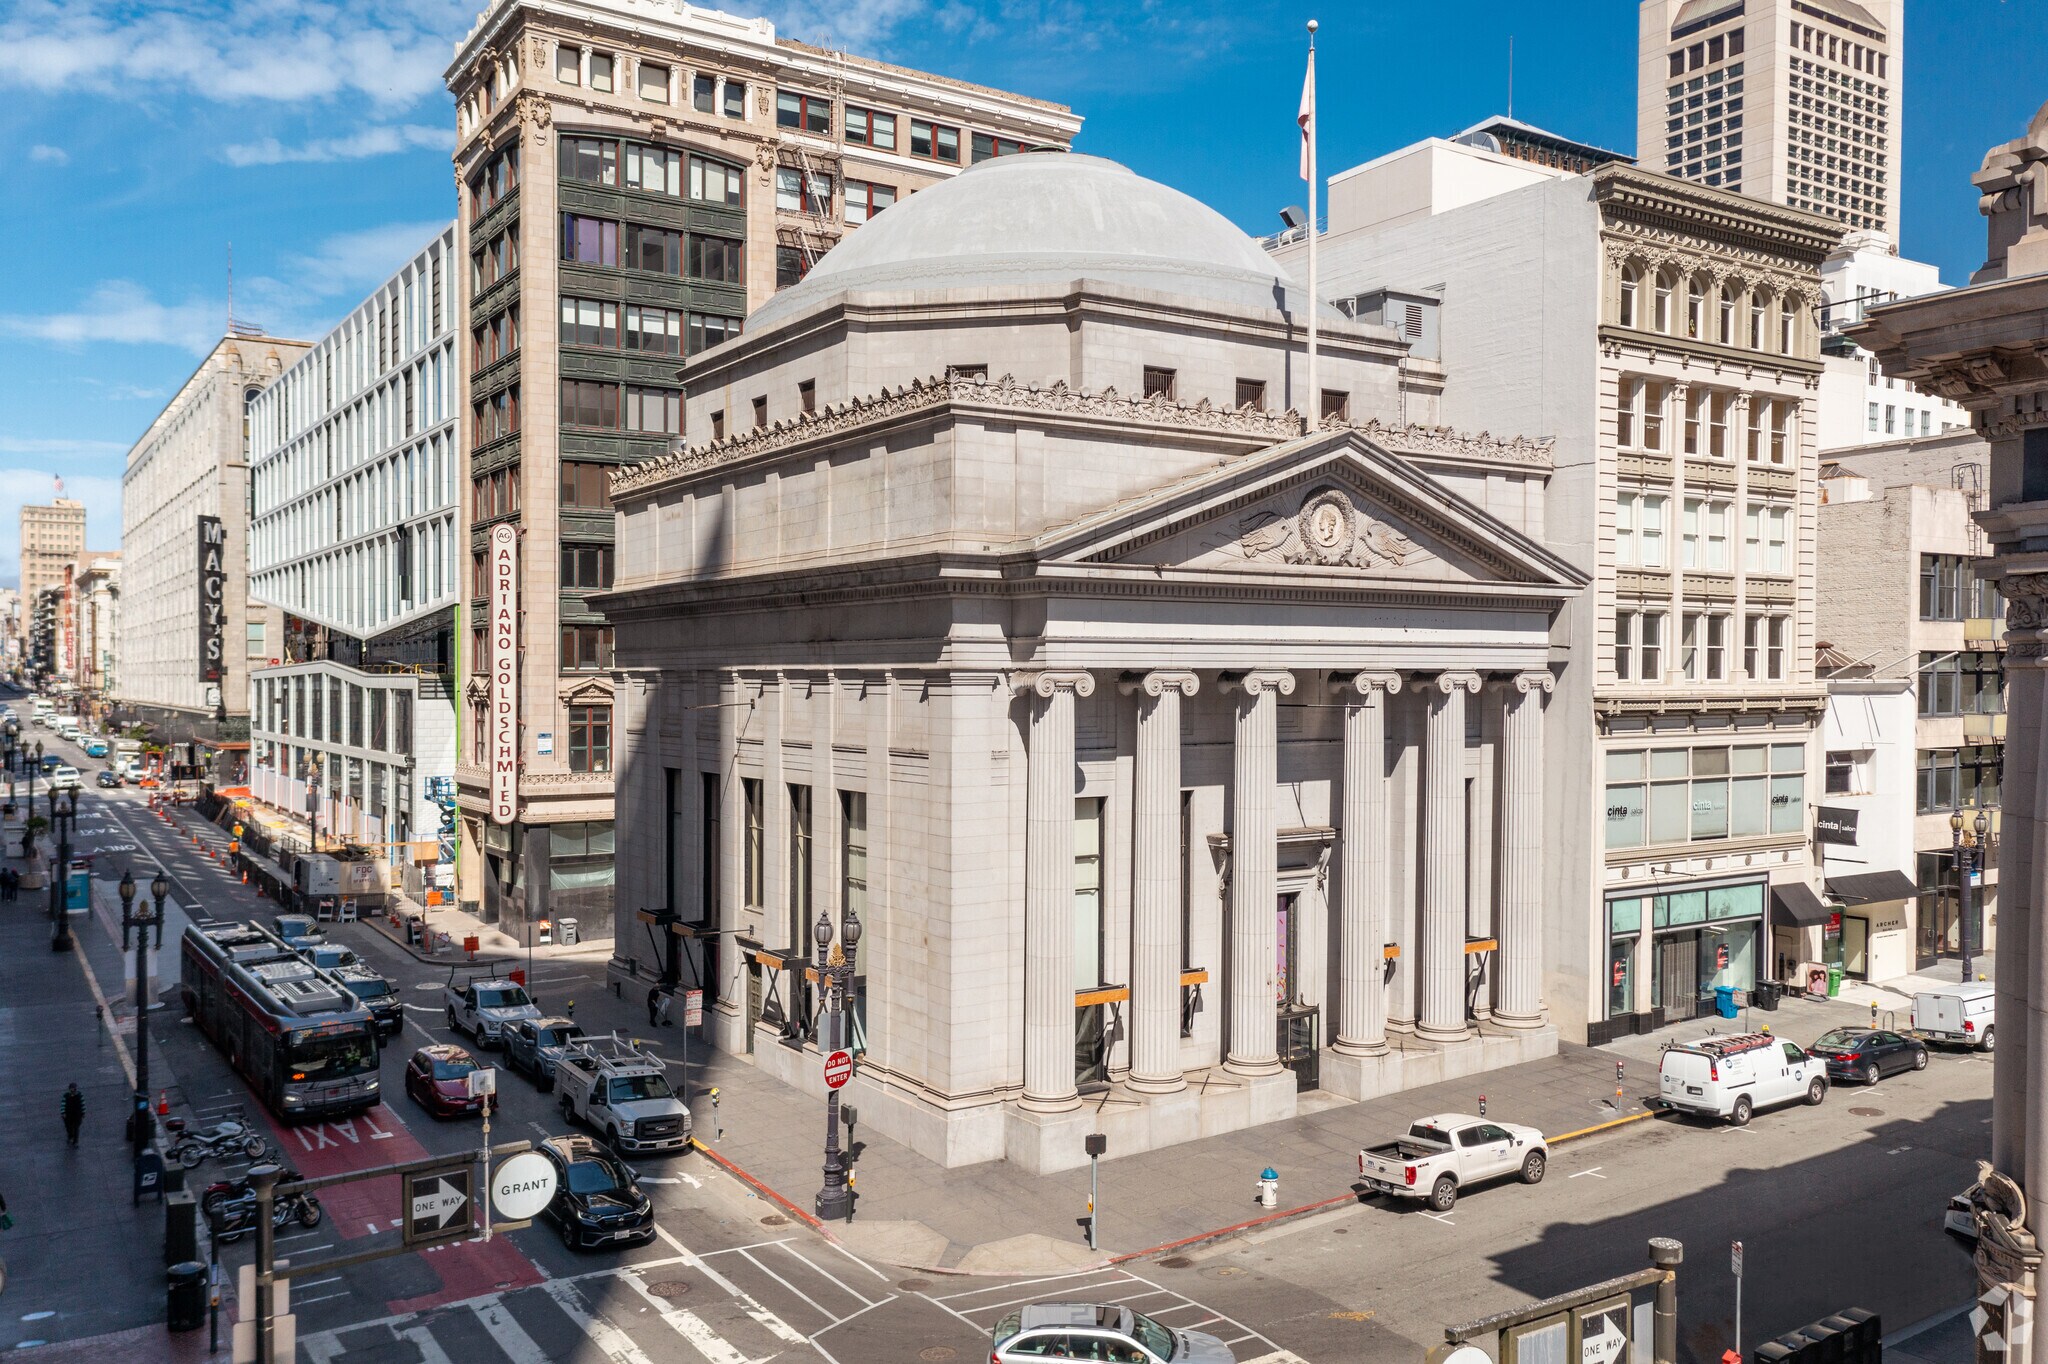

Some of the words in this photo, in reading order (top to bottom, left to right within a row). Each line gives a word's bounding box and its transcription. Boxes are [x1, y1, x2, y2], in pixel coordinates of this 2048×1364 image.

[498, 549, 511, 649] ADRIANO
[497, 658, 513, 816] GOLDSCHMIED
[1607, 805, 1627, 817] cinta
[1693, 799, 1711, 811] cinta
[1818, 820, 1838, 830] cinta
[93, 844, 137, 853] ONLY
[355, 866, 373, 874] FDC
[1876, 919, 1899, 928] ARCHER
[838, 1057, 848, 1065] NOT
[829, 1075, 848, 1084] ENTER
[293, 1115, 394, 1152] TAXI
[501, 1178, 549, 1196] GRANT
[415, 1200, 435, 1213] ONE
[442, 1195, 462, 1207] WAY
[1584, 1343, 1601, 1358] ONE
[1606, 1337, 1622, 1351] WAY
